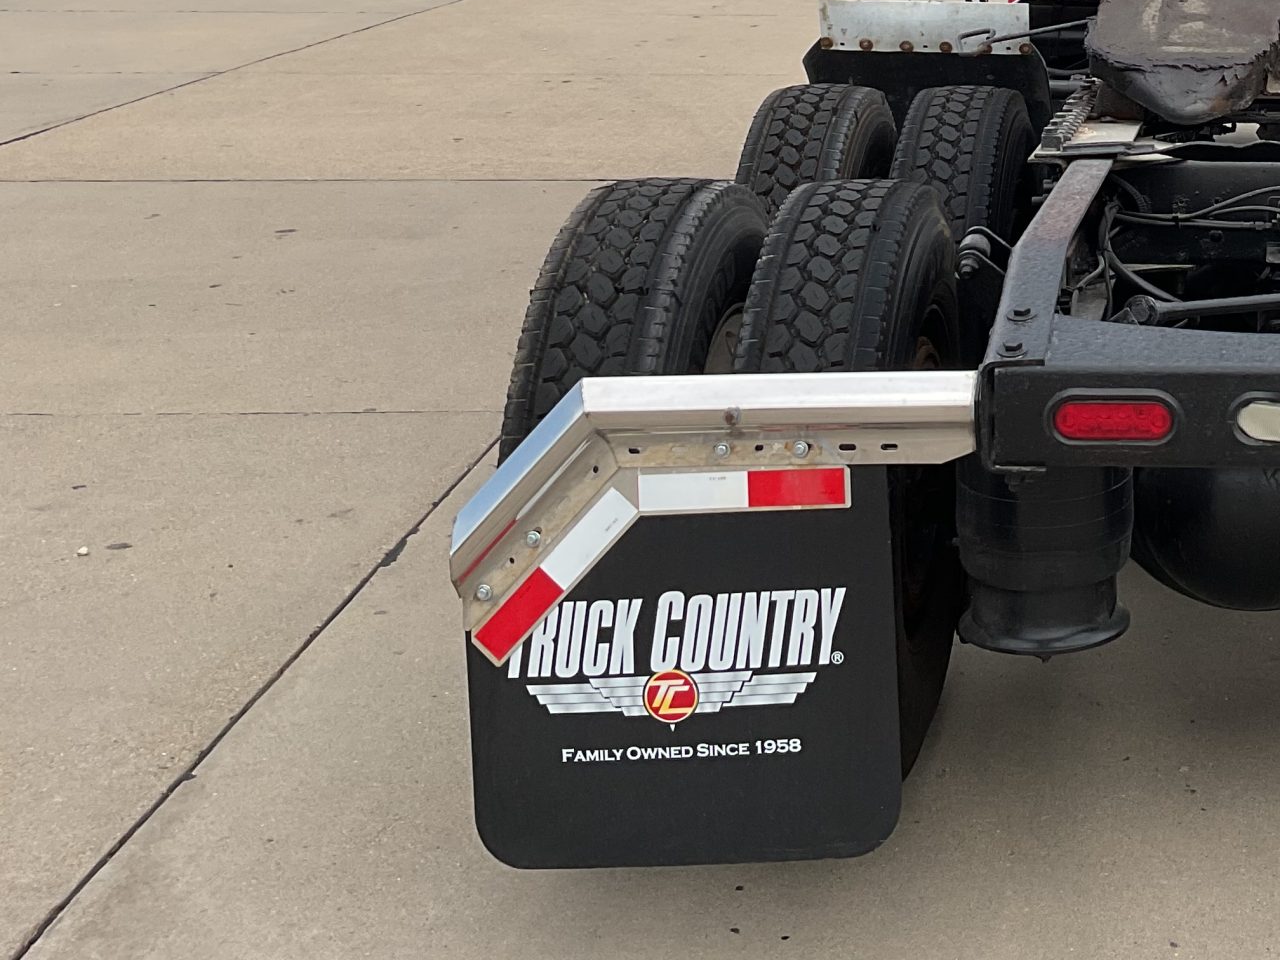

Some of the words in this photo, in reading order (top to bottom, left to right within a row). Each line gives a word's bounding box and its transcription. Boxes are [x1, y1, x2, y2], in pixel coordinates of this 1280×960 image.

[561, 747, 624, 763] FAMILY
[626, 745, 694, 761] OWNED
[696, 742, 750, 758] SINCE
[755, 738, 802, 754] 1958
